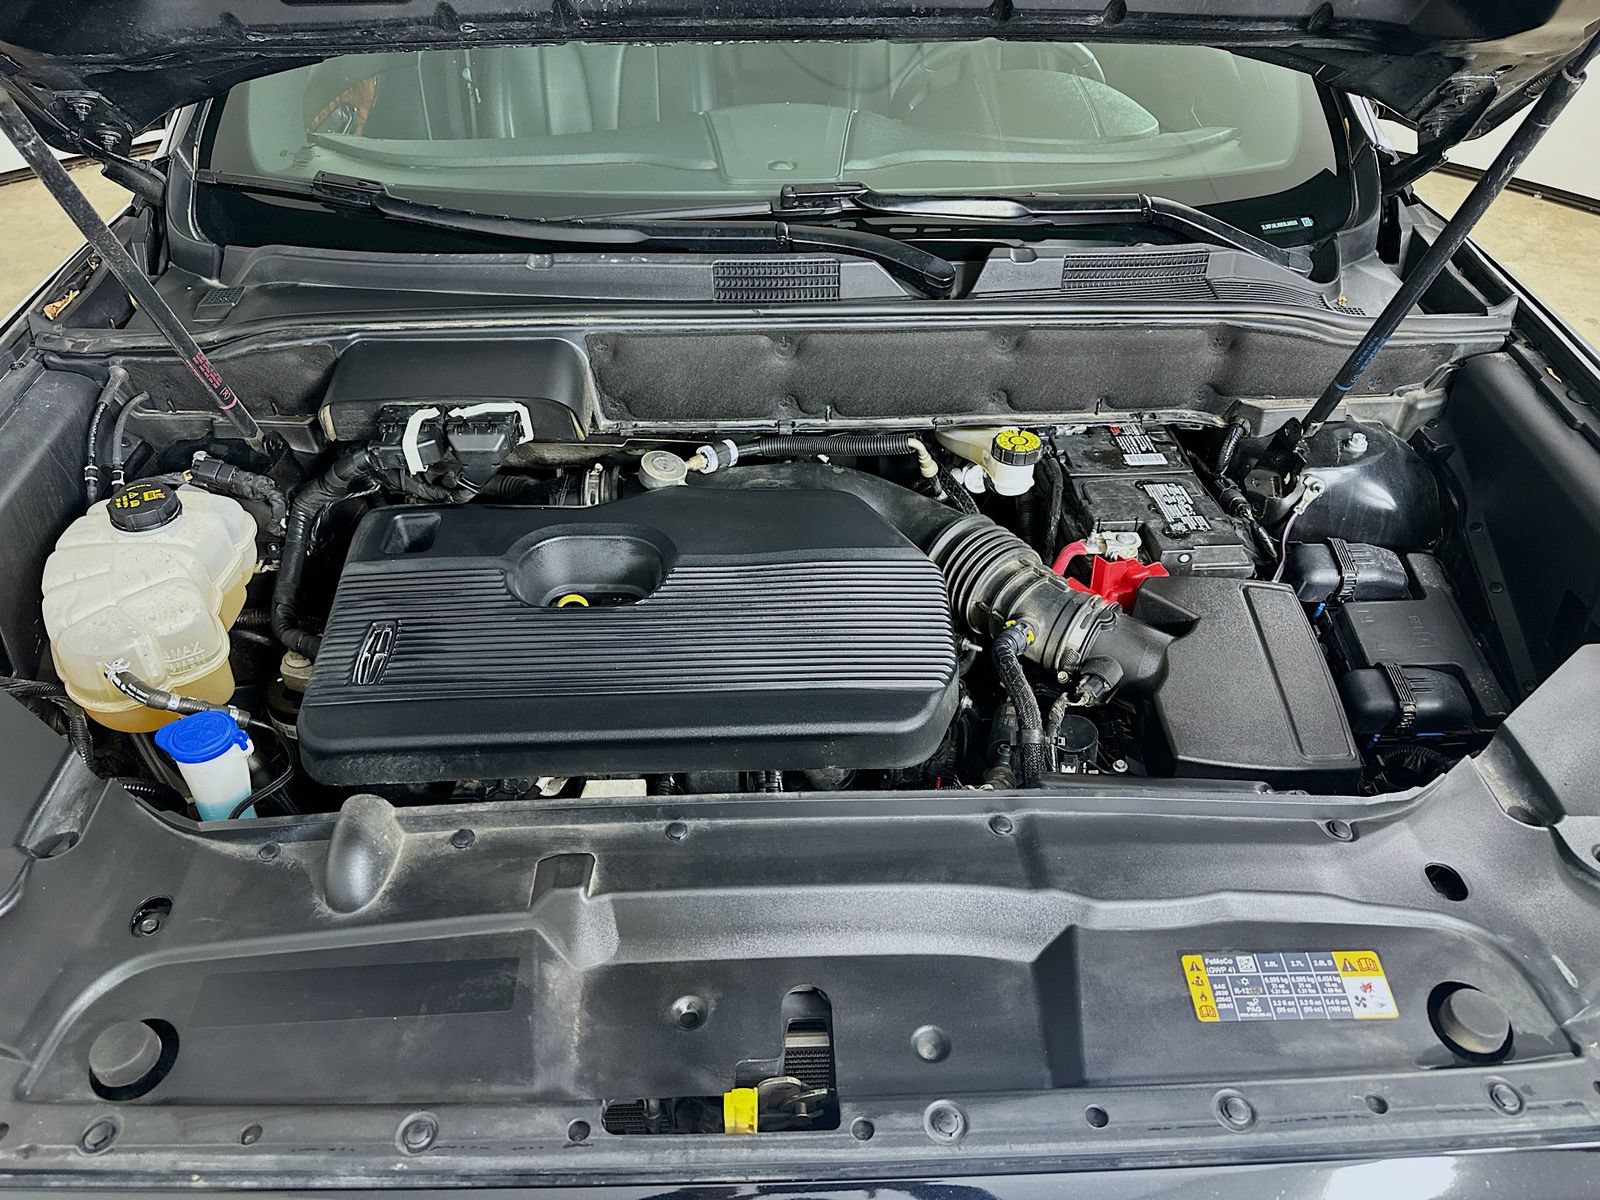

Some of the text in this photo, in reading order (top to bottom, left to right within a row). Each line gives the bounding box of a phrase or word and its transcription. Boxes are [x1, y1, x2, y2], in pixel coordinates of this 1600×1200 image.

[1204, 957, 1234, 965] FoMoCo
[1206, 966, 1227, 975] (GWP
[1246, 1005, 1263, 1013] PAG
